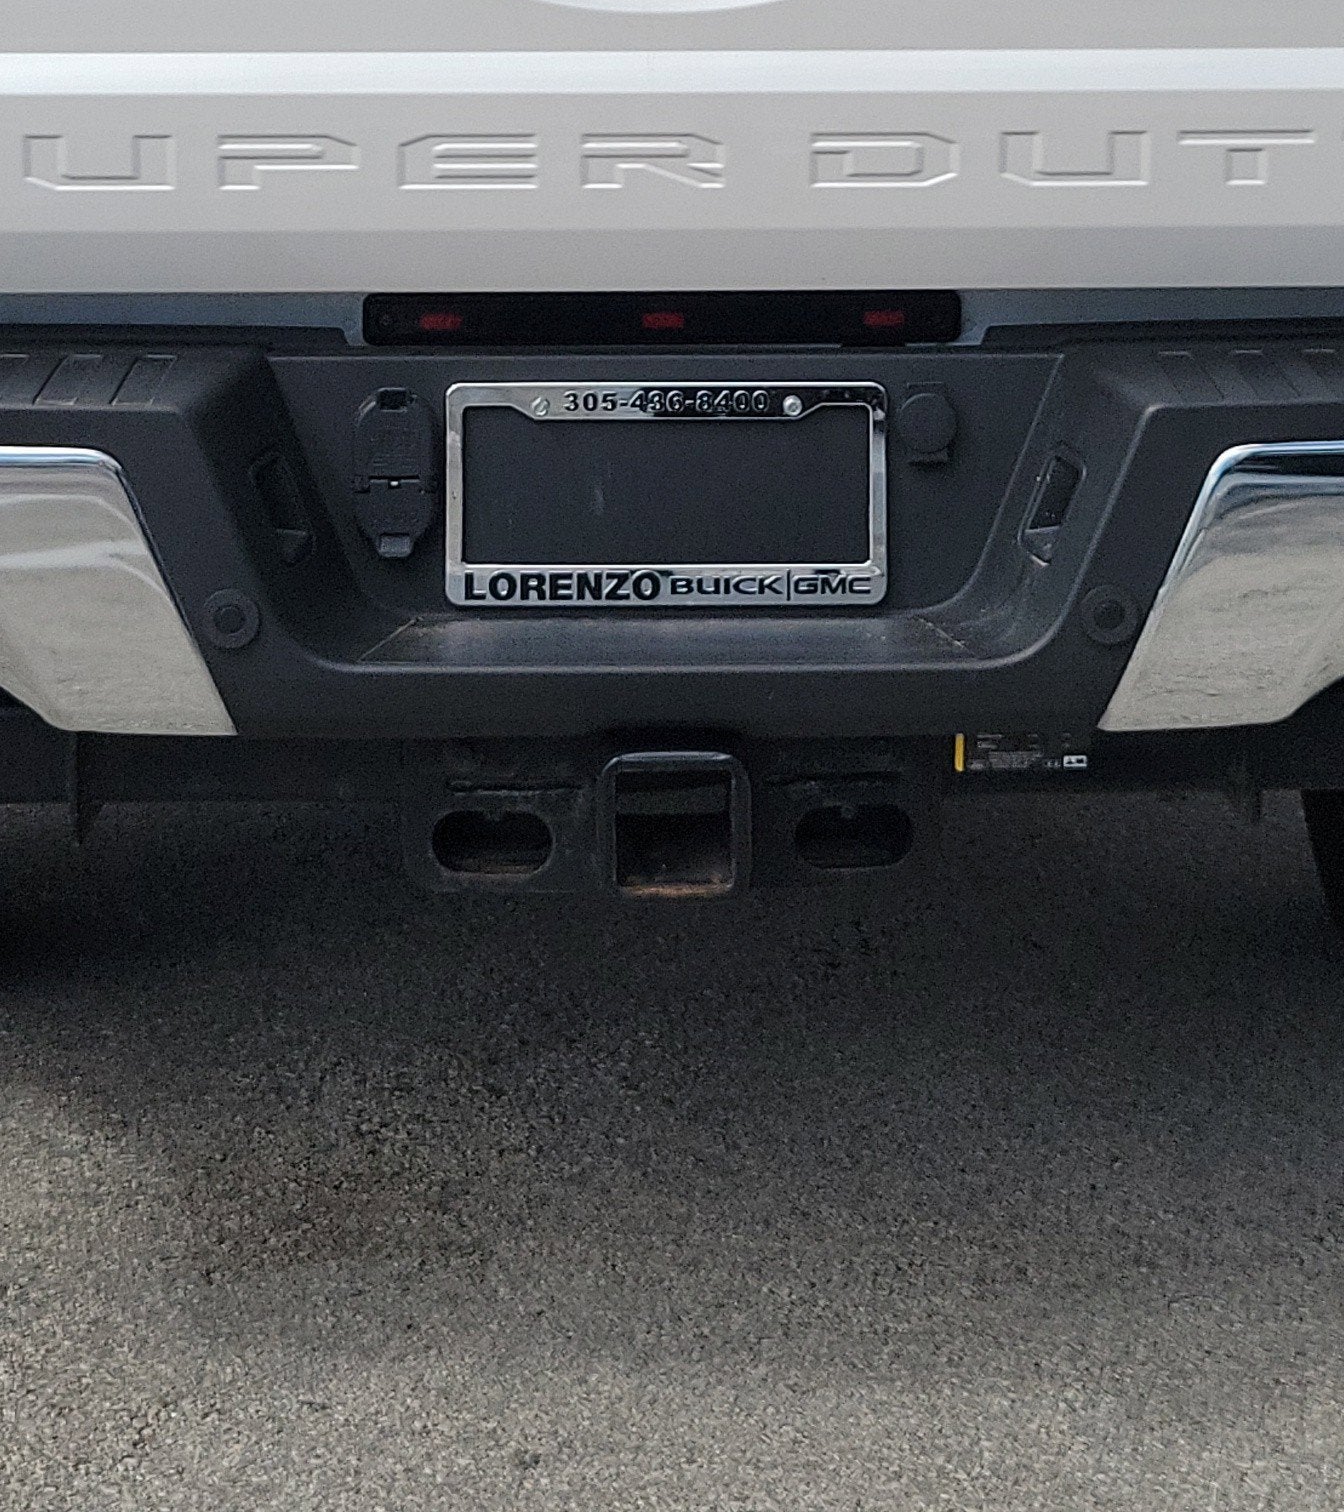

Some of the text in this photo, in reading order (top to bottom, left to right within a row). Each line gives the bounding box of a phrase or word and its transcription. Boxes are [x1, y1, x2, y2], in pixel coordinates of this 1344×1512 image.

[562, 389, 771, 413] 305-436-8400
[462, 570, 872, 602] LORENZO BUICK GMC
